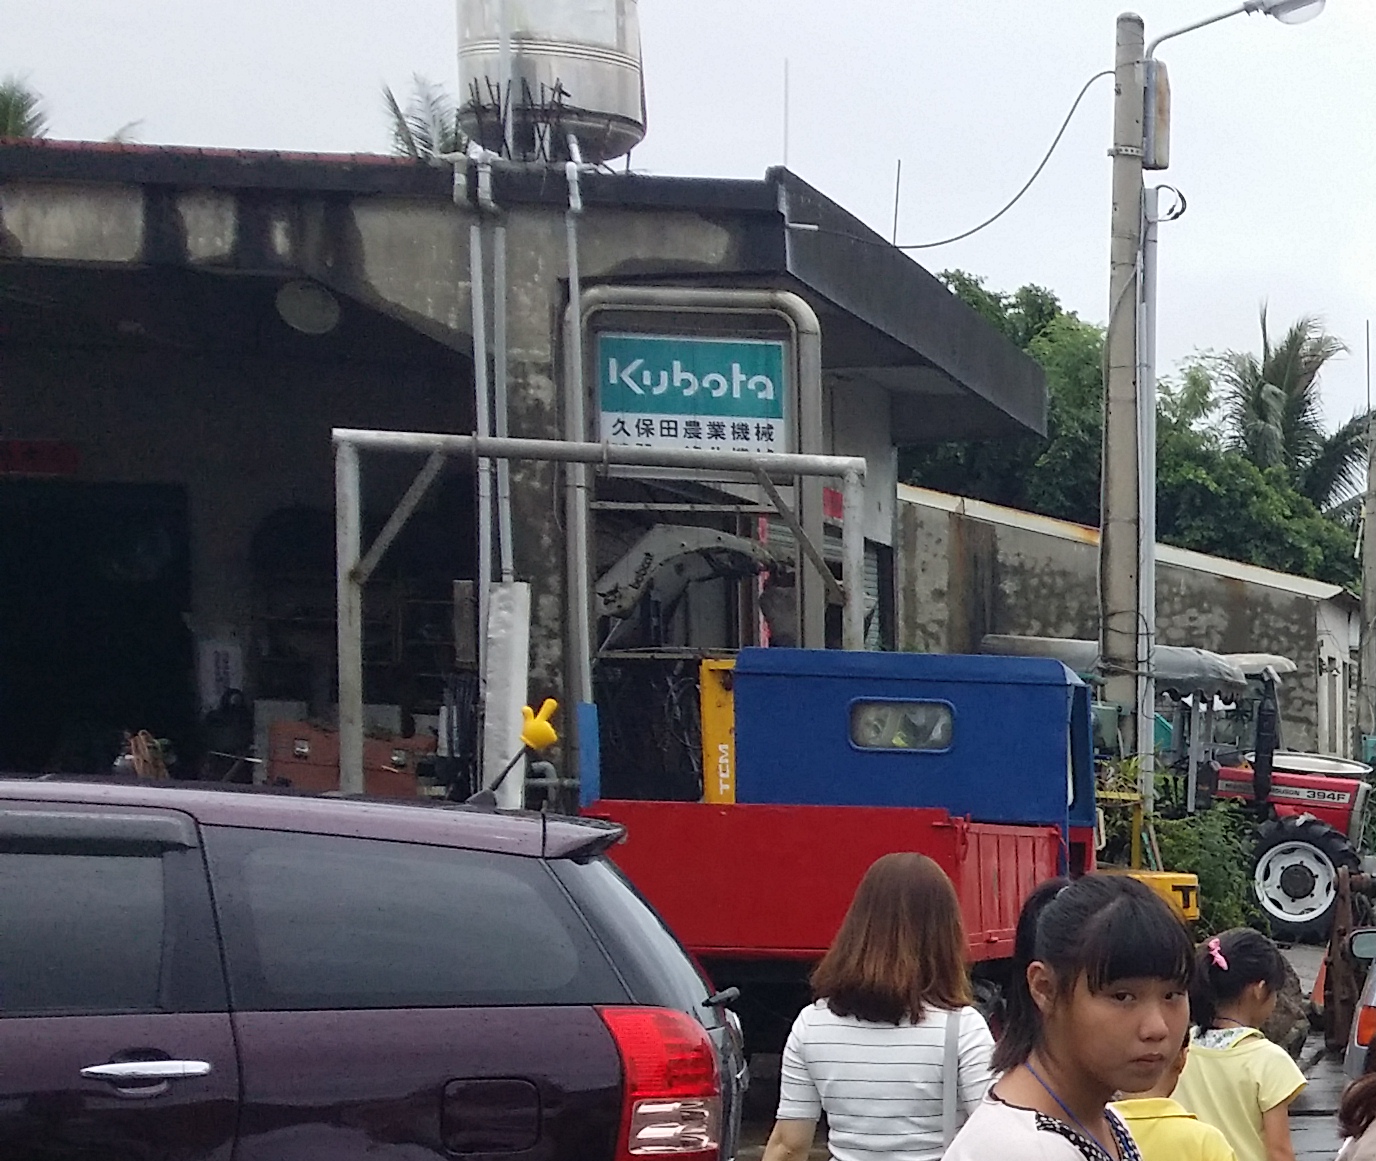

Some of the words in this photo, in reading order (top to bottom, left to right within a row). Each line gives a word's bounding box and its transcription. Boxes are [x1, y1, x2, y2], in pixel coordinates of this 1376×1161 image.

[608, 357, 774, 400] Kubota
[611, 417, 775, 443] 久保田農業機械
[718, 743, 731, 796] TCM
[1306, 790, 1346, 802] 394F
